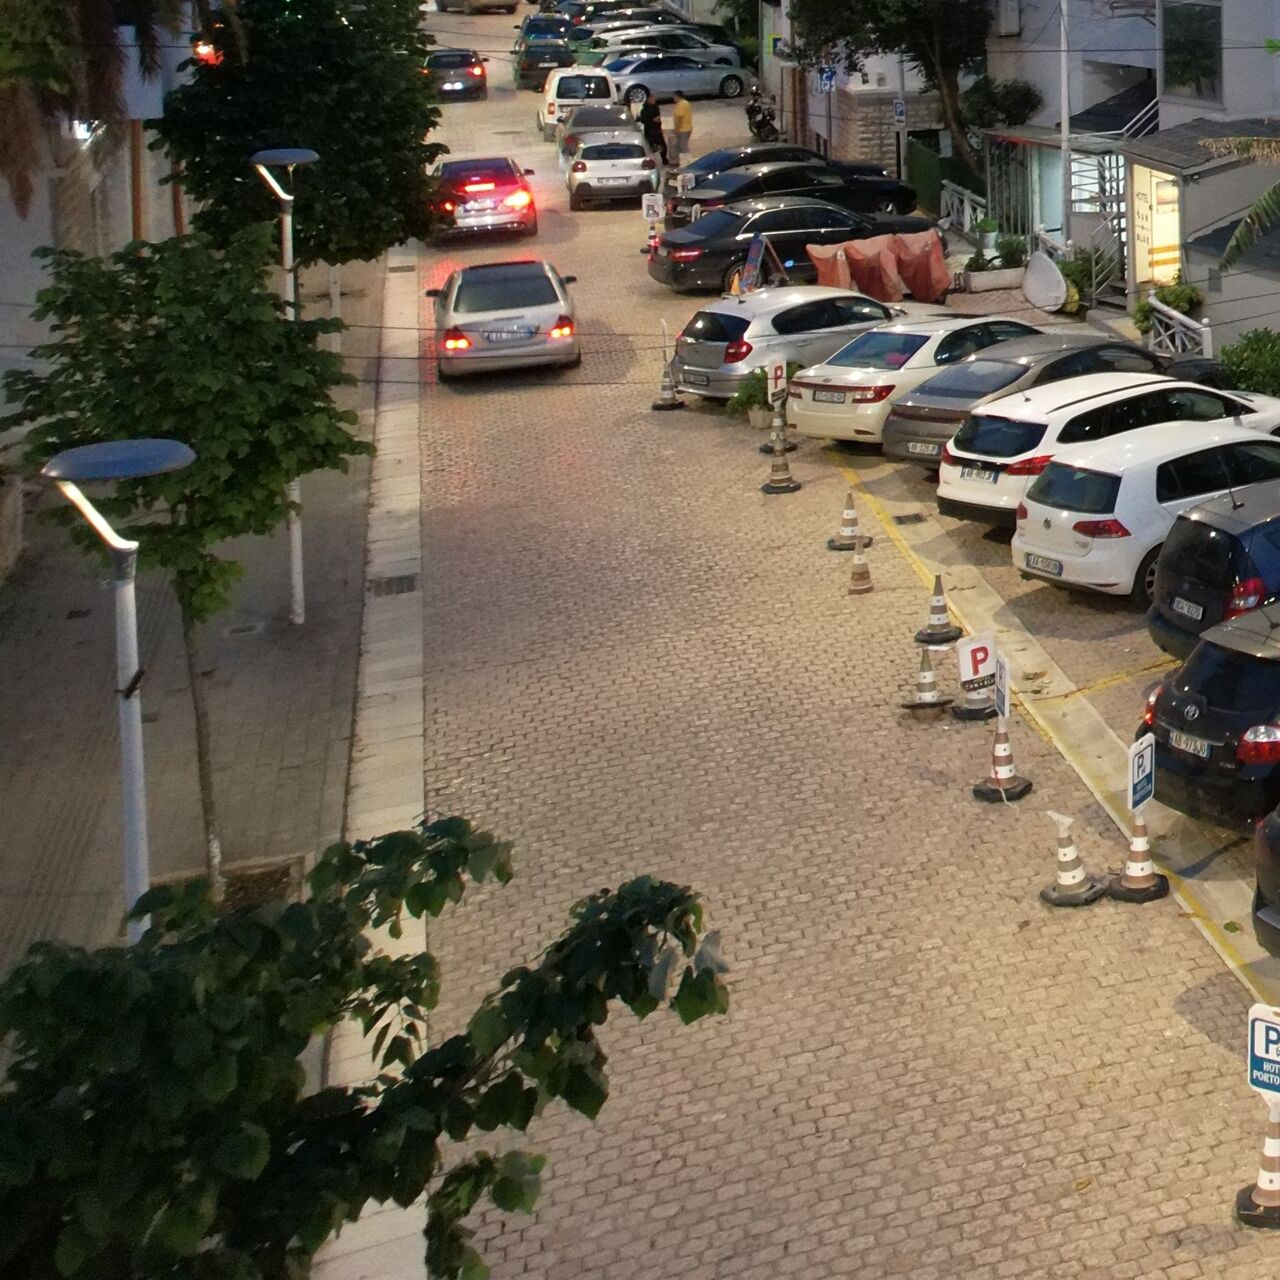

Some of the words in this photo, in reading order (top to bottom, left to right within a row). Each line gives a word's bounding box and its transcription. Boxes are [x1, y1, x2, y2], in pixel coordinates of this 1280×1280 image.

[774, 365, 784, 390] P
[970, 646, 989, 677] P
[1137, 753, 1145, 780] P
[1252, 1068, 1280, 1085] PORTO
